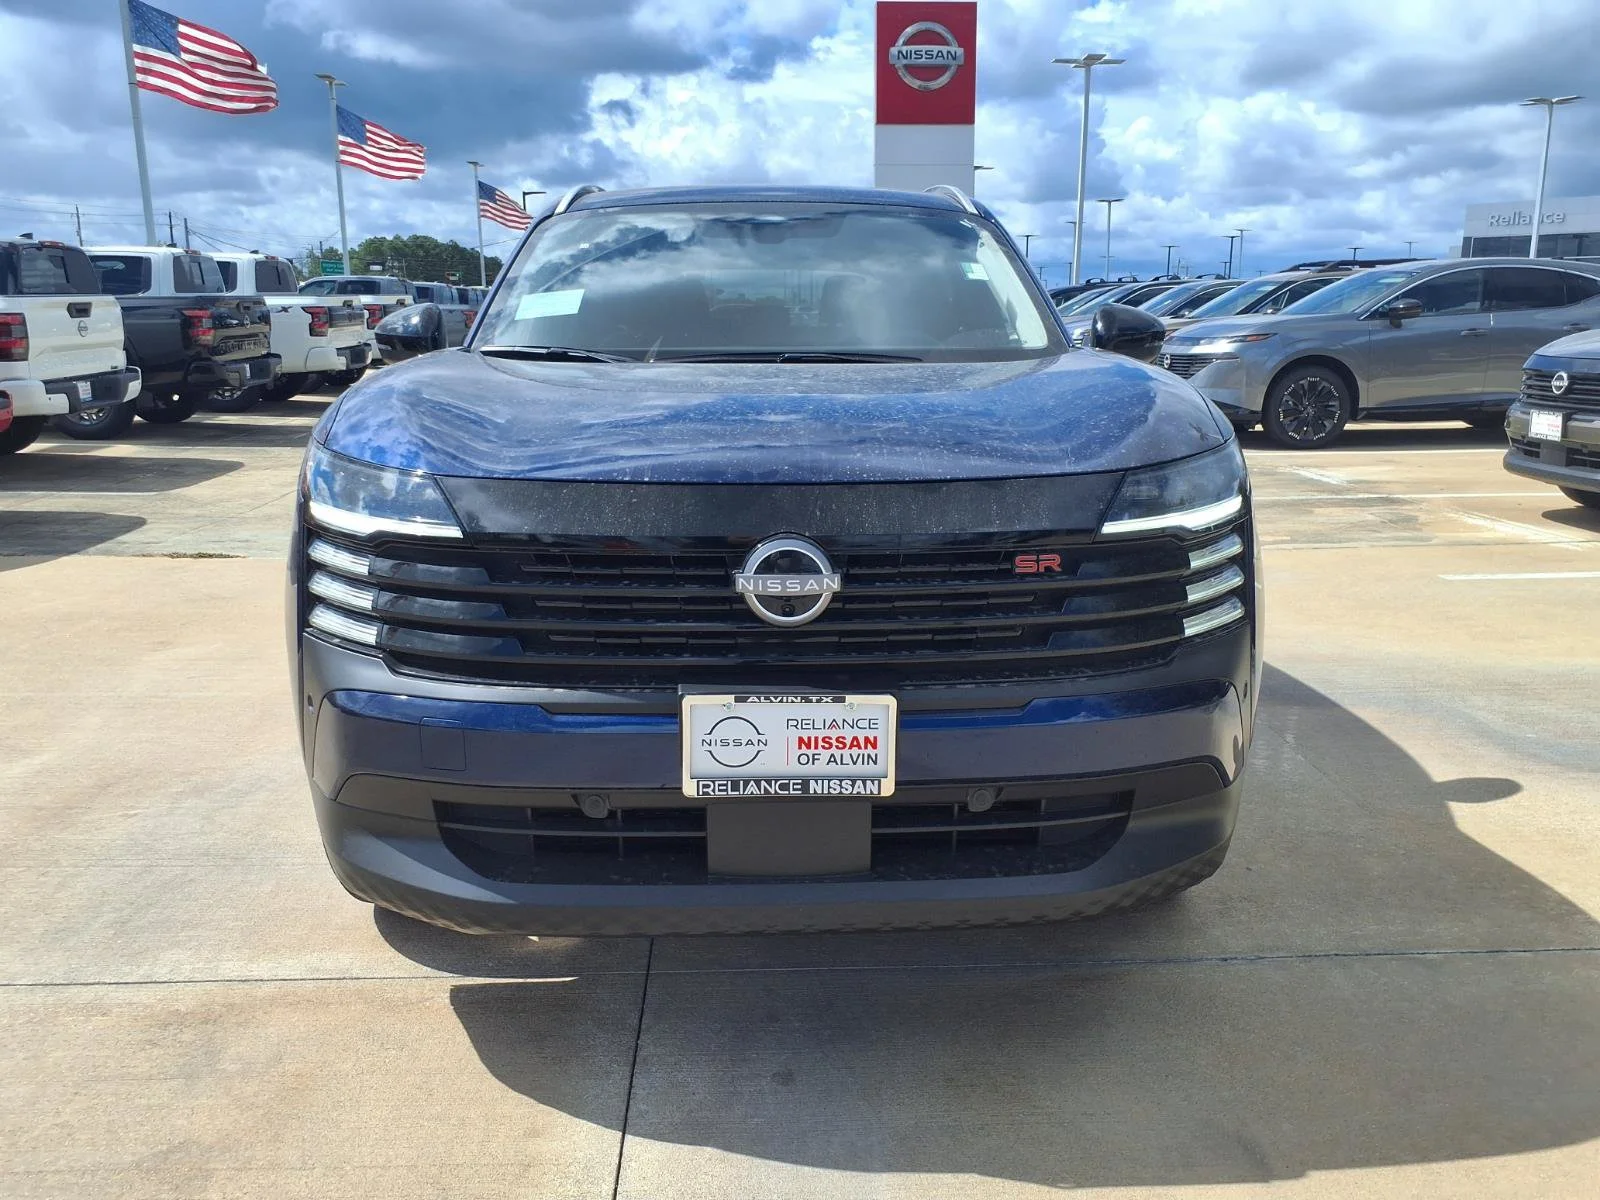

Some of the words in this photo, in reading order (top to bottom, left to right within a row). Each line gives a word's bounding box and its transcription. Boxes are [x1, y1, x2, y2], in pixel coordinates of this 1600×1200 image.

[897, 49, 957, 61] NISSAN
[1014, 554, 1062, 573] SR
[738, 576, 838, 592] NISSAN
[809, 695, 833, 703] TX
[787, 718, 879, 730] RELIANCE
[702, 738, 767, 747] NISSAN
[797, 735, 878, 750] NISSAN
[797, 753, 821, 766] OF
[826, 753, 878, 766] ALVIN
[700, 780, 801, 795] RELIANCE
[809, 779, 879, 794] NISSAN
